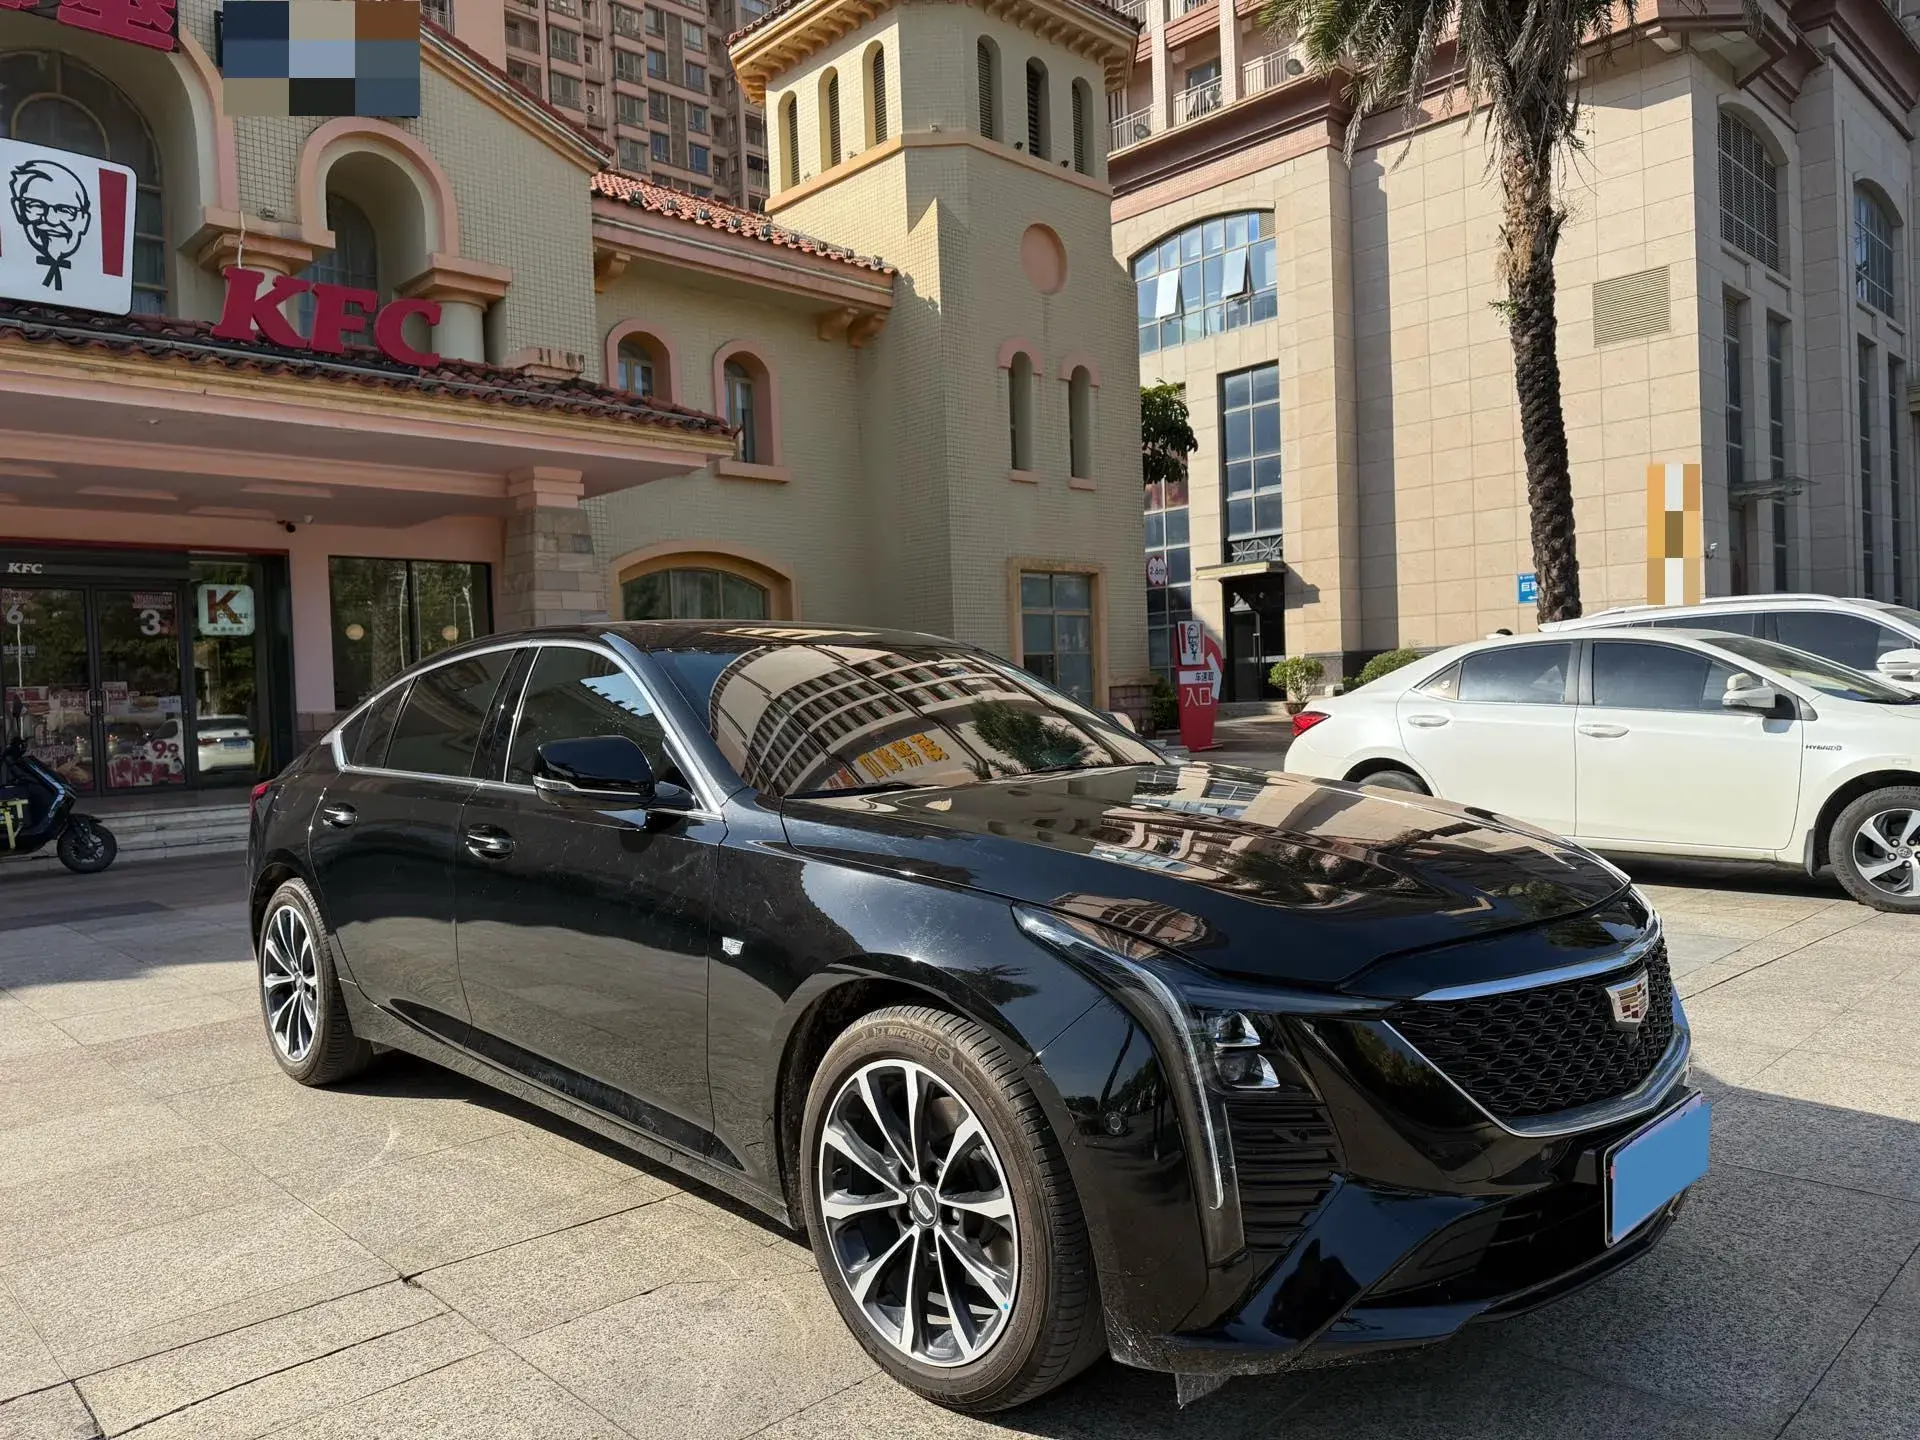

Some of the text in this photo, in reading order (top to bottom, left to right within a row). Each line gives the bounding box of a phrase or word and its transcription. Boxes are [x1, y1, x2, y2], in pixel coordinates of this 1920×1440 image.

[211, 266, 441, 367] KFC
[7, 563, 42, 574] KFC
[207, 589, 244, 625] K
[140, 609, 160, 636] 3
[1184, 687, 1212, 708] 入口
[887, 1027, 938, 1052] MICHELIN
